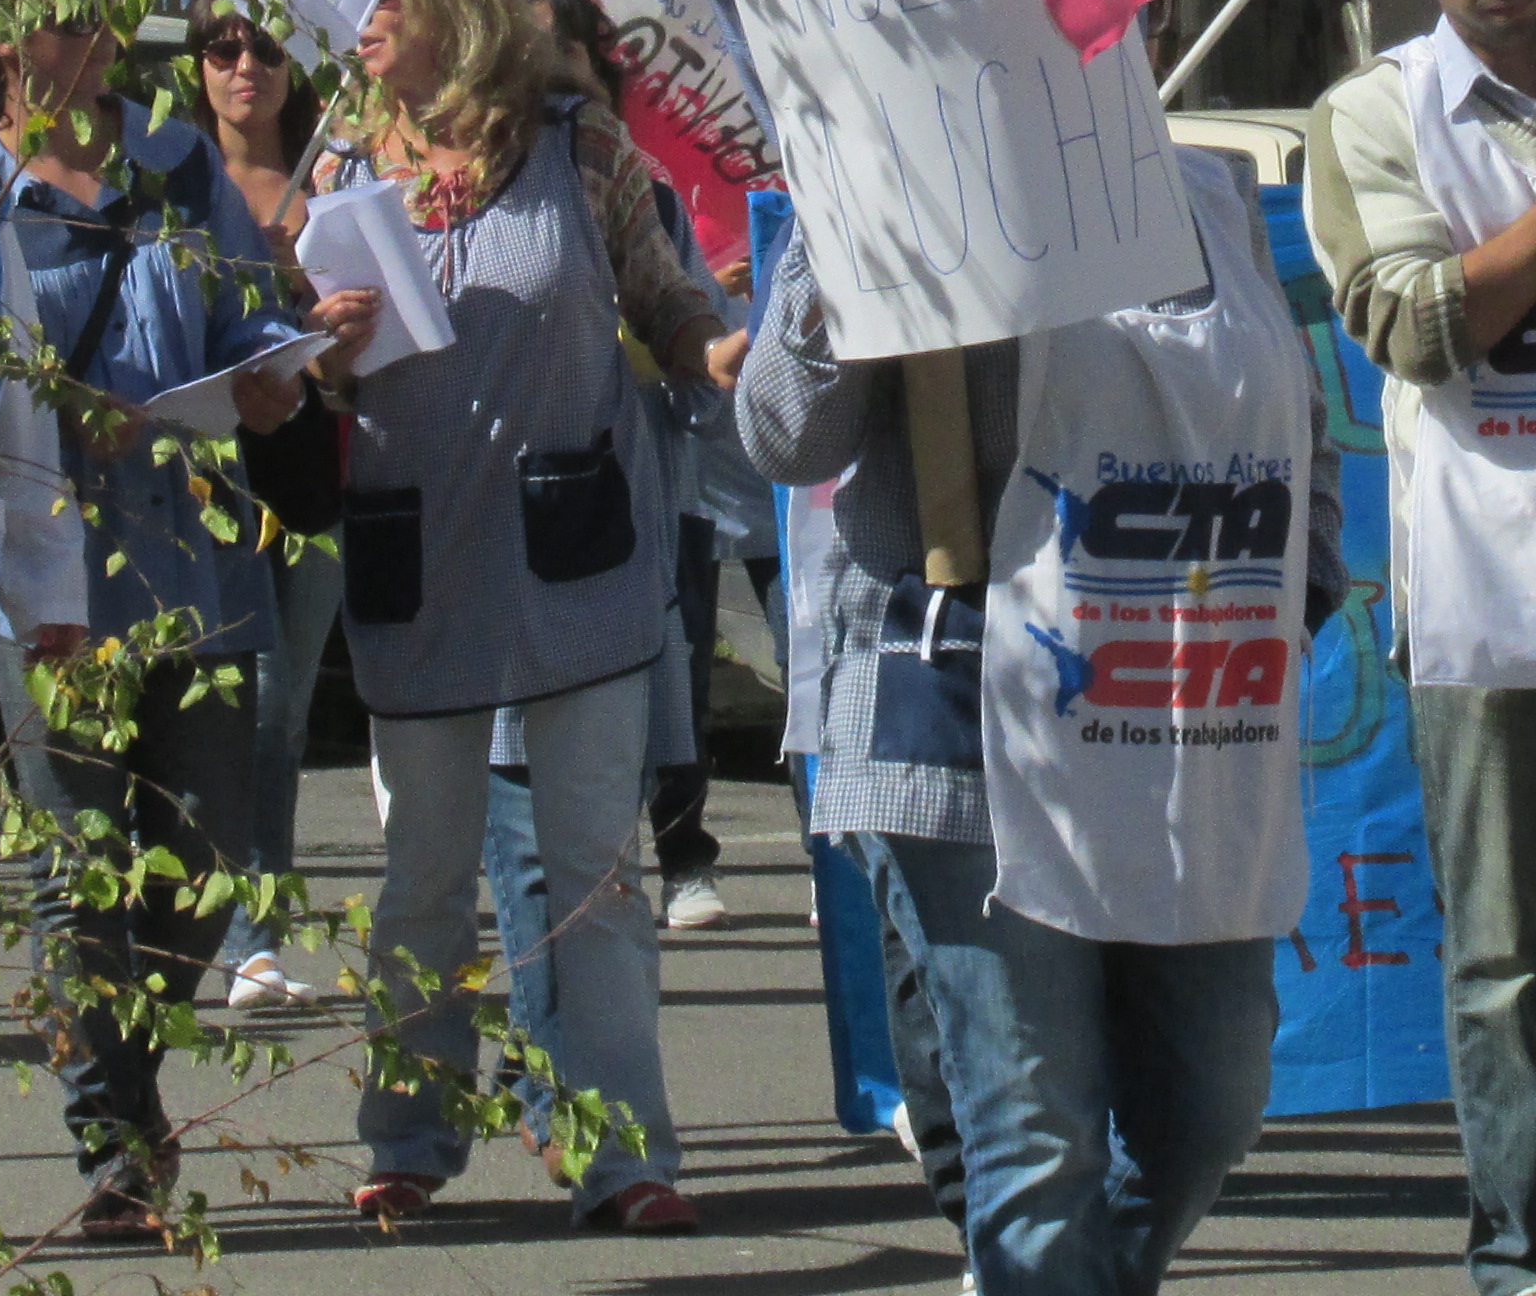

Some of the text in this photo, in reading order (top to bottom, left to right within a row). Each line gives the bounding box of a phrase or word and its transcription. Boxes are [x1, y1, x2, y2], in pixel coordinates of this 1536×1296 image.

[816, 40, 1185, 293] LUCHA
[1477, 417, 1511, 437] de
[1097, 452, 1292, 484] Buenos Aires
[1079, 480, 1292, 561] CTA
[1072, 600, 1102, 621] de
[1110, 602, 1152, 622] los
[1082, 637, 1289, 708] CTA
[1081, 718, 1114, 744] de
[1120, 720, 1162, 745] los
